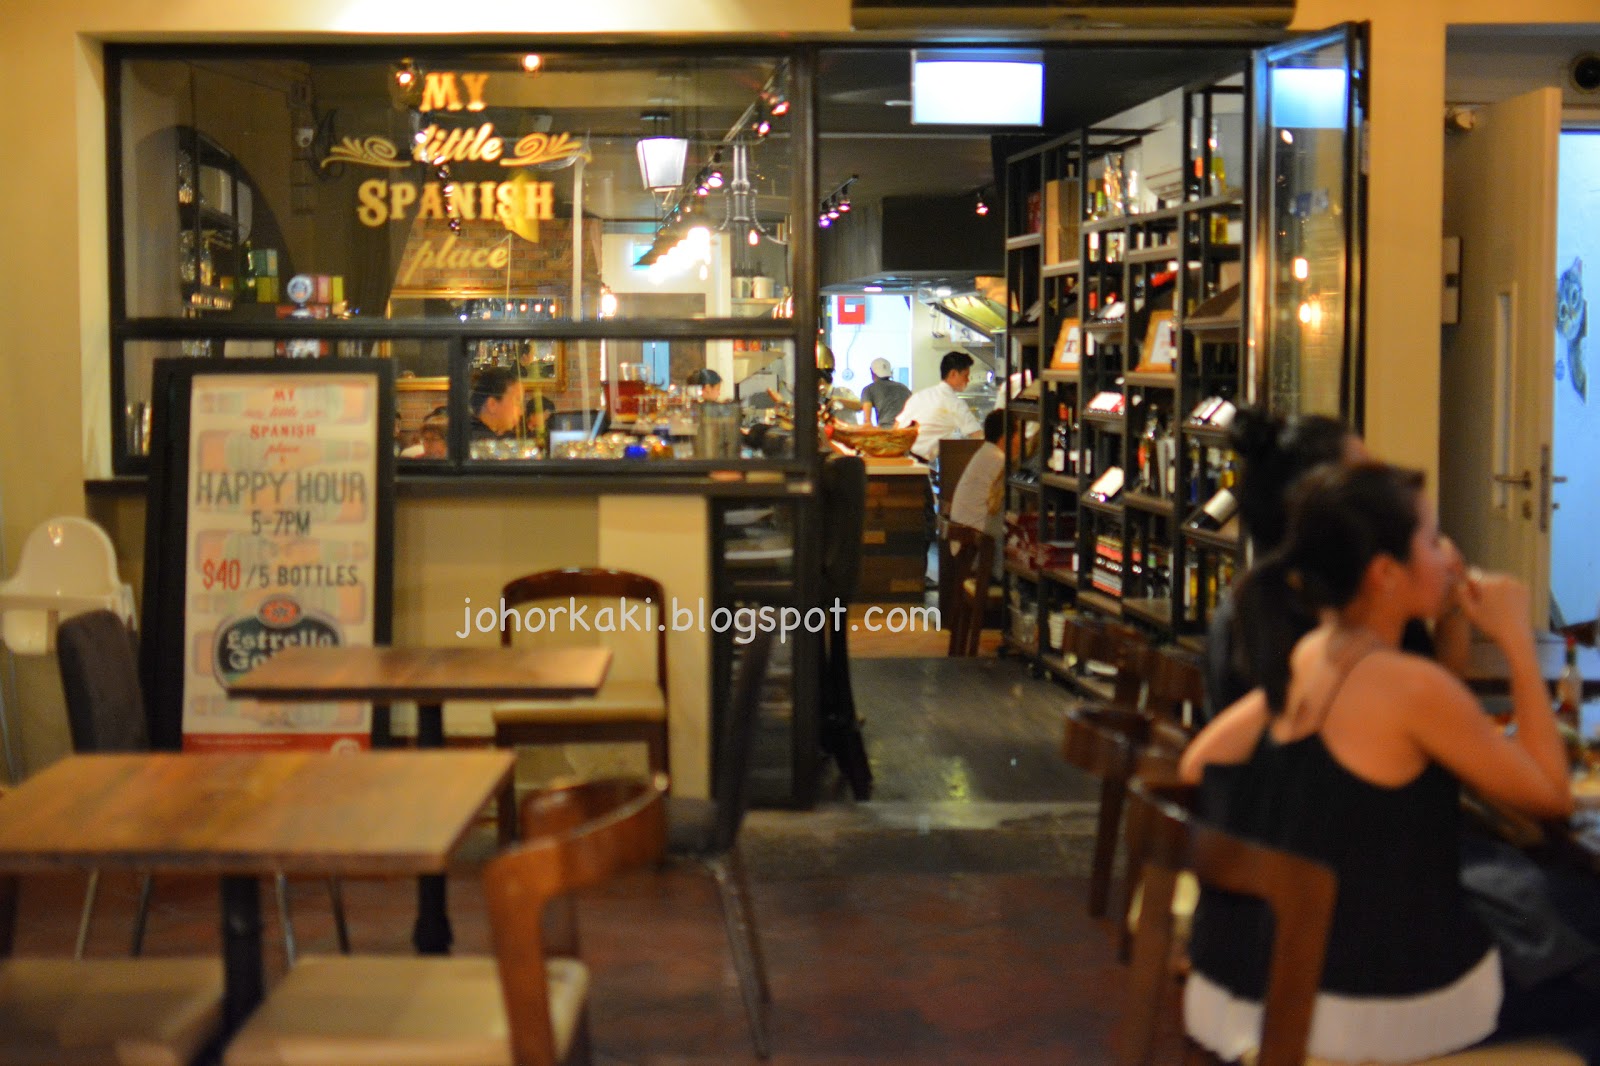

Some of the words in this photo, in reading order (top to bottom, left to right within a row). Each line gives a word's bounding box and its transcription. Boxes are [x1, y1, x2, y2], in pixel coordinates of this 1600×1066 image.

[419, 72, 488, 111] MY
[412, 122, 502, 162] little
[357, 179, 555, 227] SPANISH
[403, 235, 508, 284] place
[250, 424, 316, 439] SPANISH
[197, 471, 285, 505] HAPPY
[297, 471, 366, 504] HOUR
[251, 510, 310, 536] 5-7PM
[277, 564, 358, 586] BOTTLES
